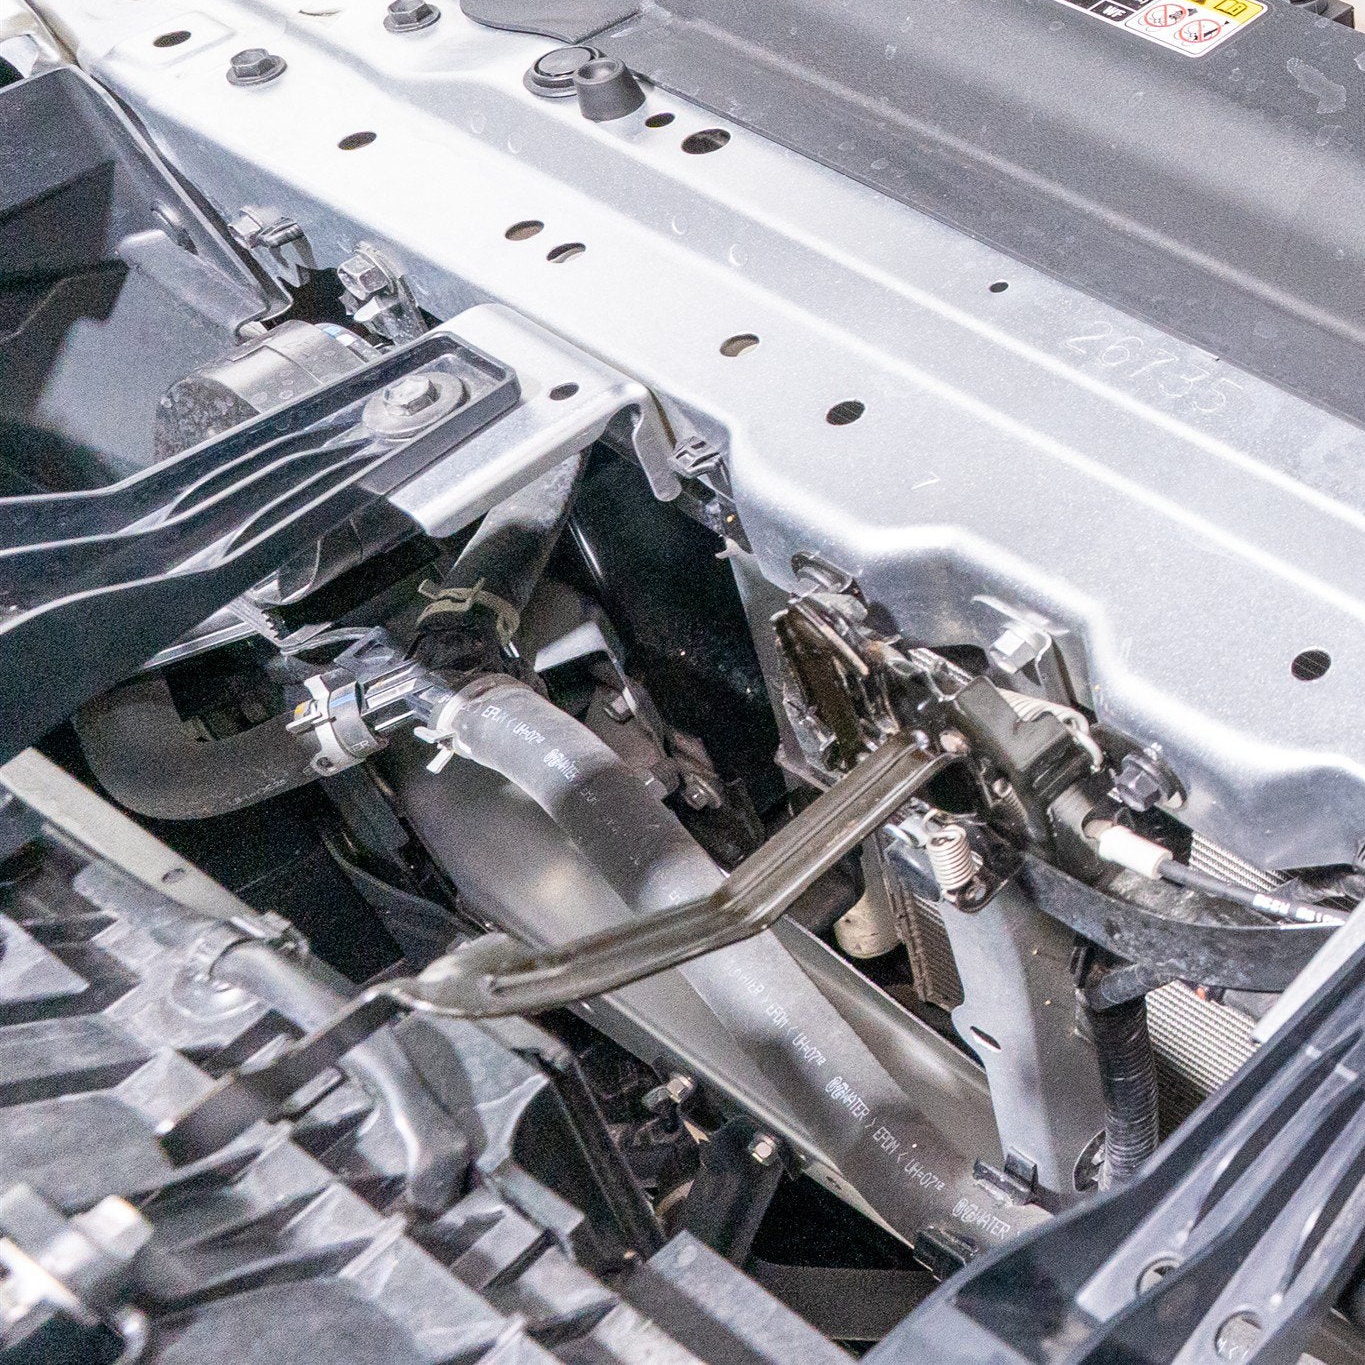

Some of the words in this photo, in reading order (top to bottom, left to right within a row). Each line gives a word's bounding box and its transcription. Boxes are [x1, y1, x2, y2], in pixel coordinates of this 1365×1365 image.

[1102, 5, 1127, 18] WF
[1063, 320, 1244, 412] 26735
[873, 1126, 901, 1155] EPDM
